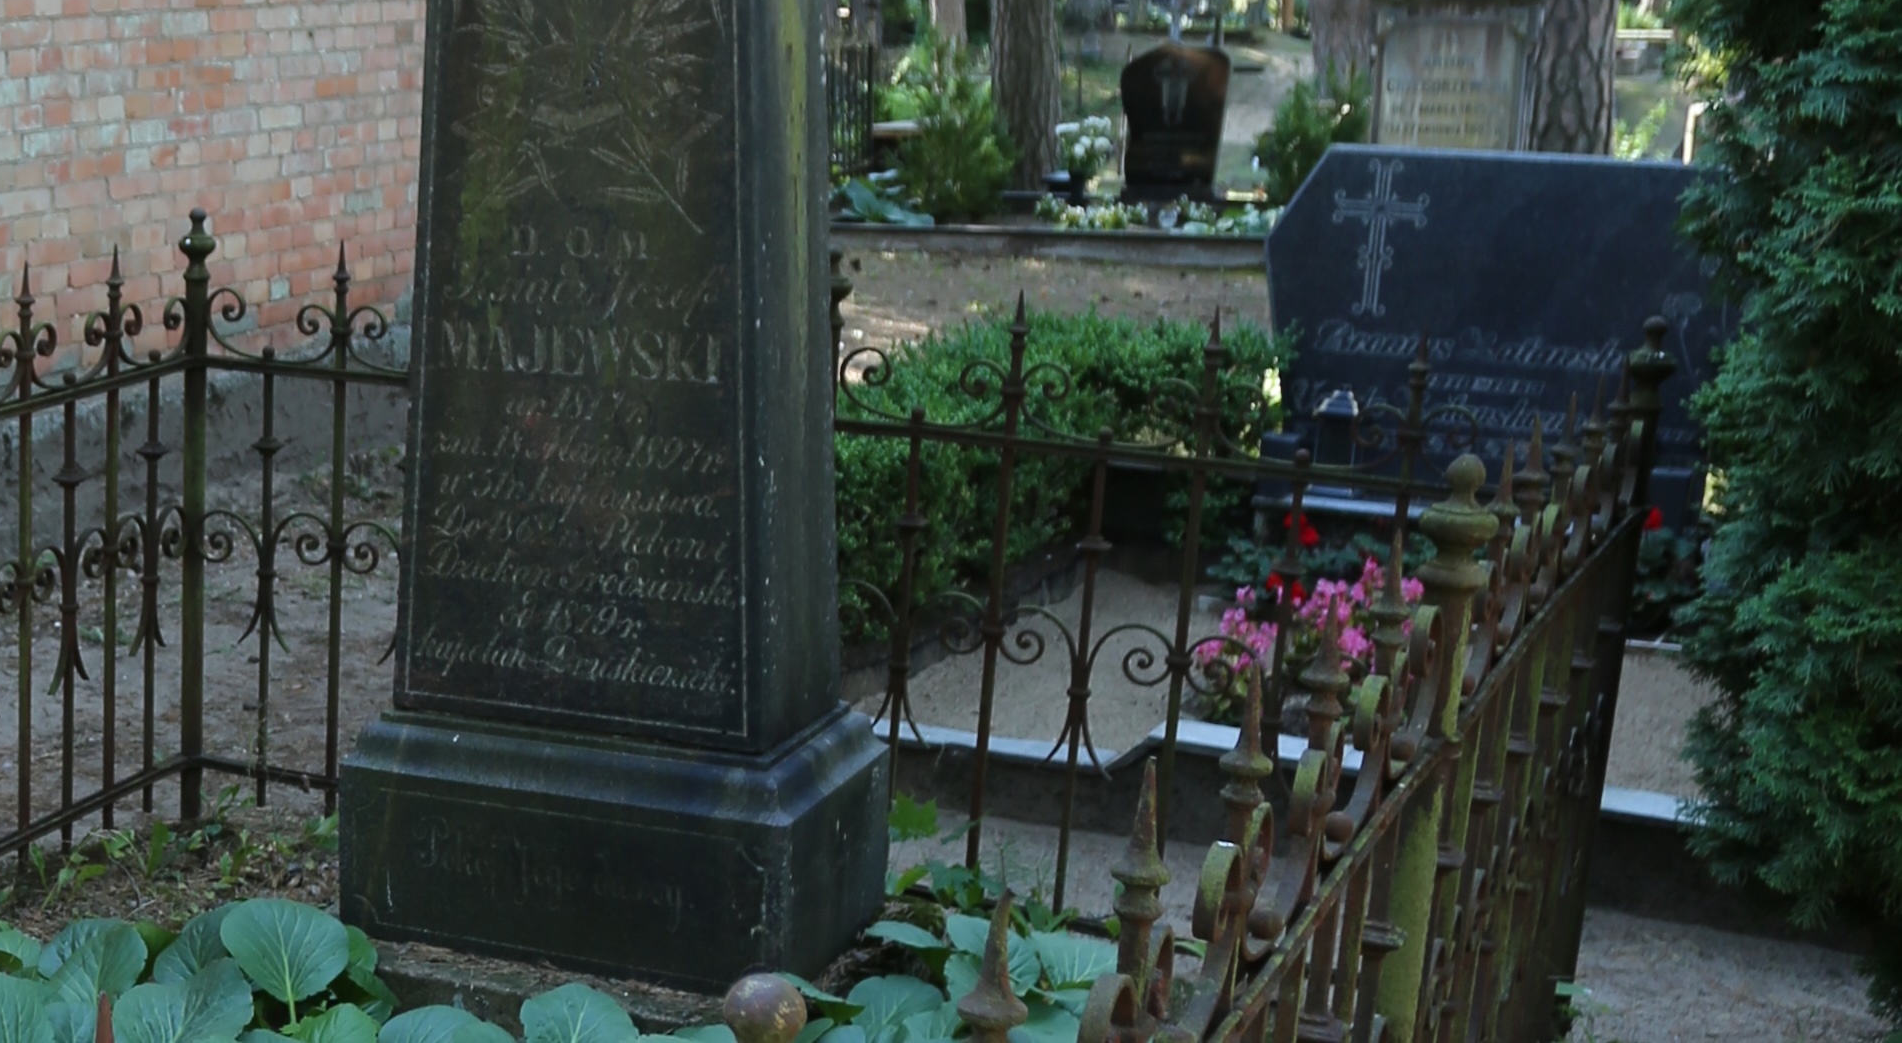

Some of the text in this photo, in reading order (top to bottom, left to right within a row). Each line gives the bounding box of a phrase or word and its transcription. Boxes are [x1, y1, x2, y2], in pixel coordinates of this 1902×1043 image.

[438, 318, 723, 384] MAJEWSKI
[590, 512, 708, 561] Pleban
[416, 539, 555, 589] Dziekan
